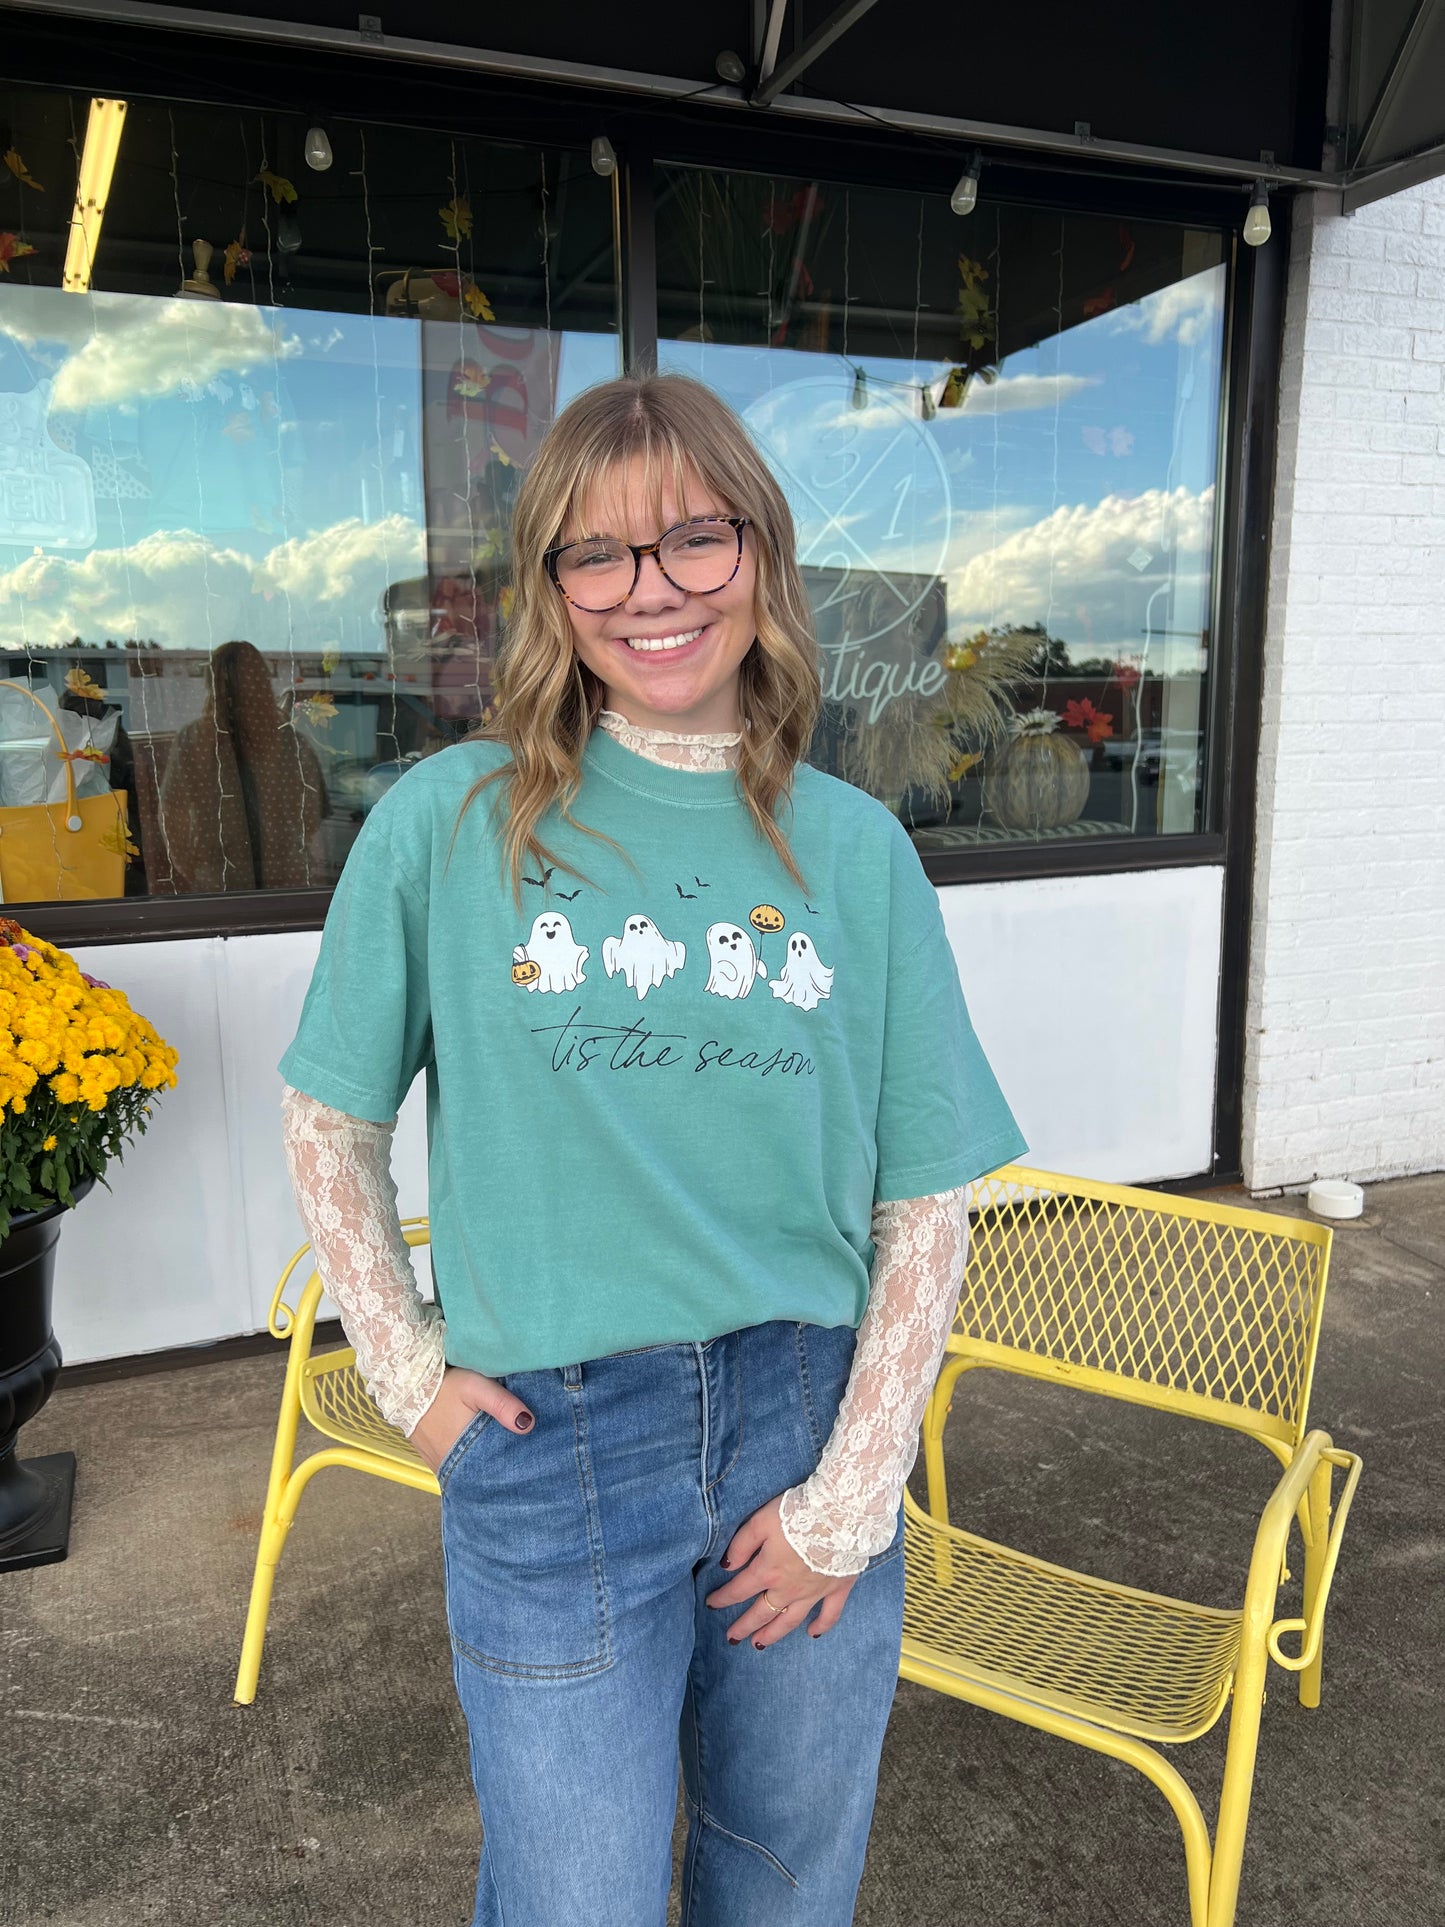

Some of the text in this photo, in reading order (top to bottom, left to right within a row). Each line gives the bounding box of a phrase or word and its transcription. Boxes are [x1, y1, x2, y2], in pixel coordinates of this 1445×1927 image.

[811, 424, 862, 489] 3
[881, 473, 912, 541] 1
[812, 550, 861, 615] 2
[609, 1017, 687, 1070] the
[695, 1040, 816, 1077] season
